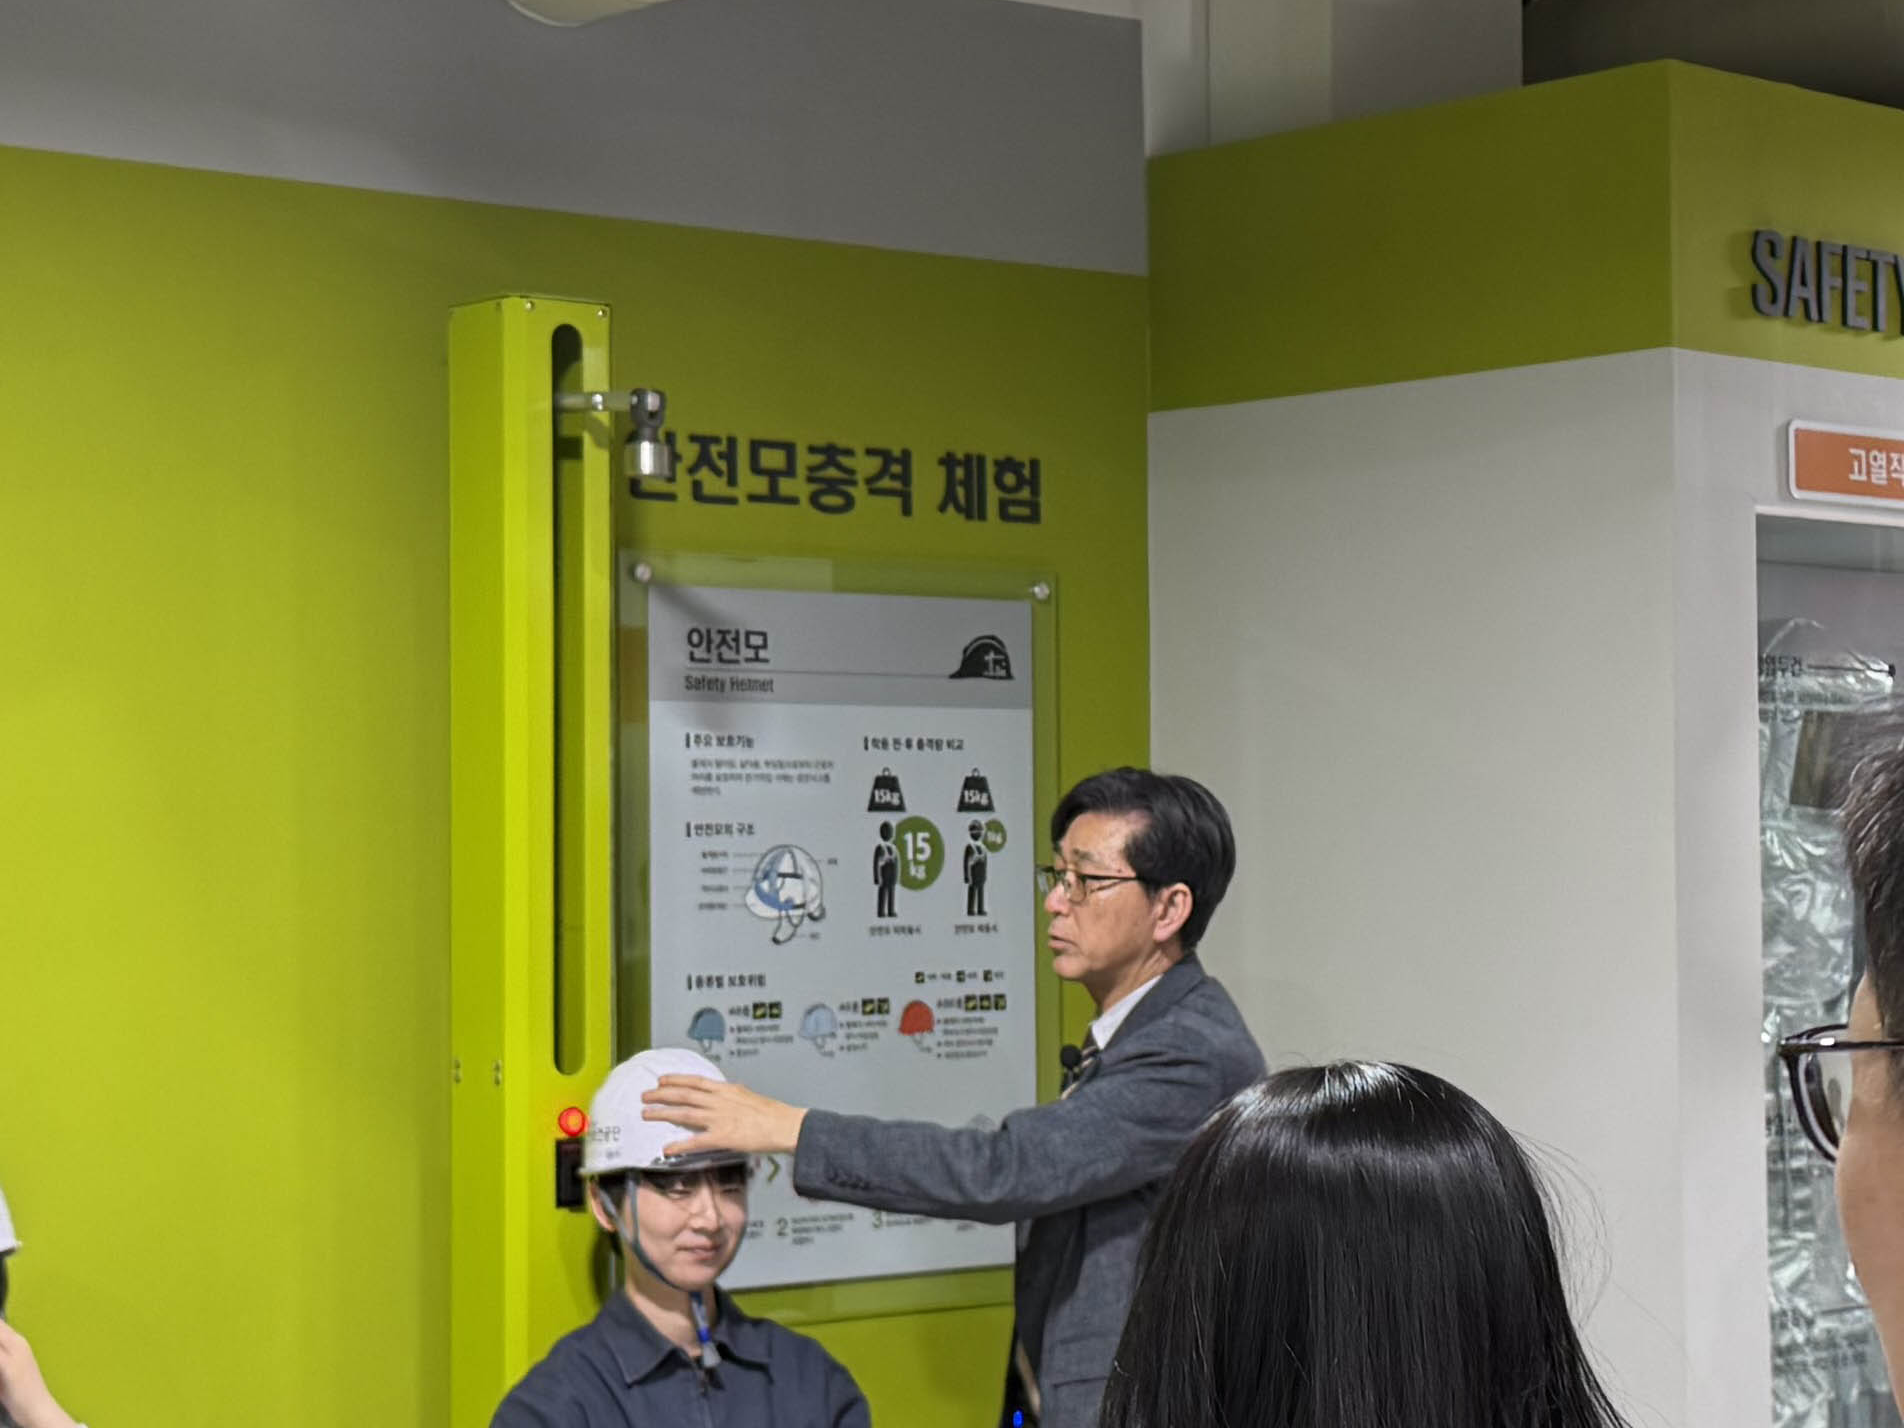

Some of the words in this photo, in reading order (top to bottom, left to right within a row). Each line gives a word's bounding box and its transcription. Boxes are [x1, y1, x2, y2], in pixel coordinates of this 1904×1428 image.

[937, 450, 1042, 525] 체험
[687, 627, 770, 664] 안전모
[685, 675, 725, 693] Safety
[730, 676, 774, 693] Helmet
[874, 788, 901, 807] 15kg
[963, 788, 989, 807] 15kg
[904, 831, 932, 862] 15
[909, 863, 926, 880] kg
